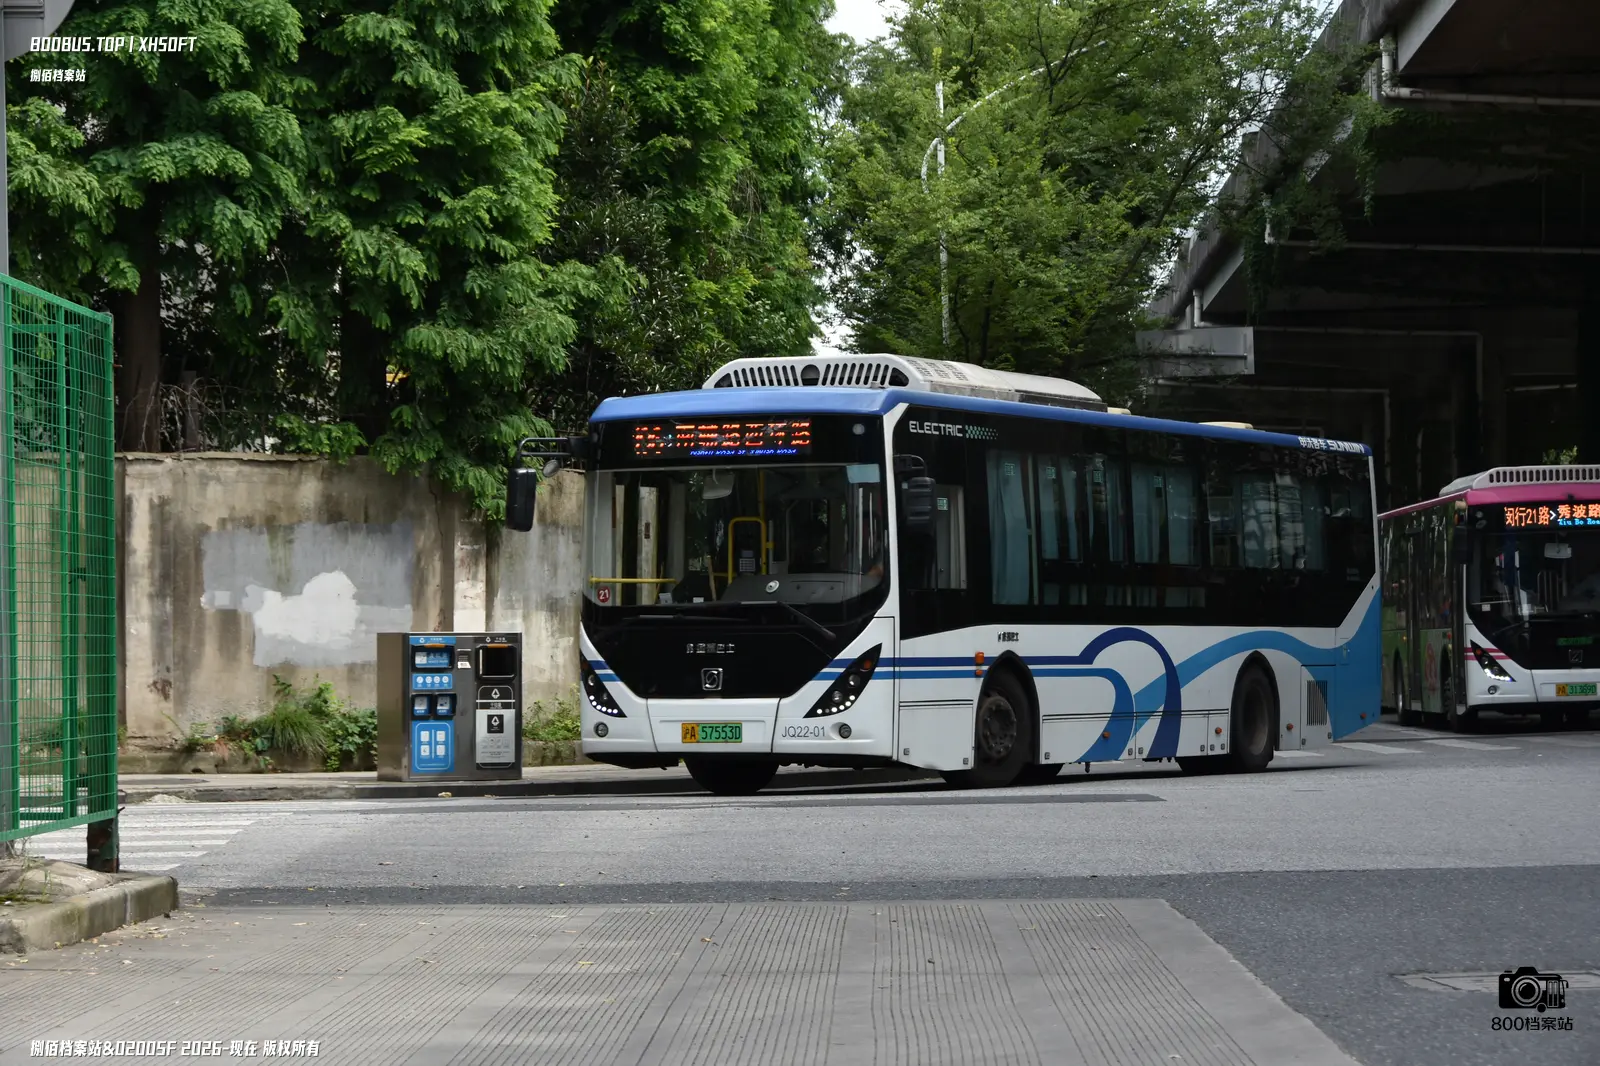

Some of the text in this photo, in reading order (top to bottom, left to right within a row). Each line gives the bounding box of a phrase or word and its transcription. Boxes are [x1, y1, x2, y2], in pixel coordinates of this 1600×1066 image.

[908, 420, 963, 437] ELECTRIC
[1326, 439, 1365, 454] SUNWIN
[1503, 505, 1550, 527] 闵行21路
[599, 589, 609, 600] 21
[781, 725, 826, 739] JQ22-01
